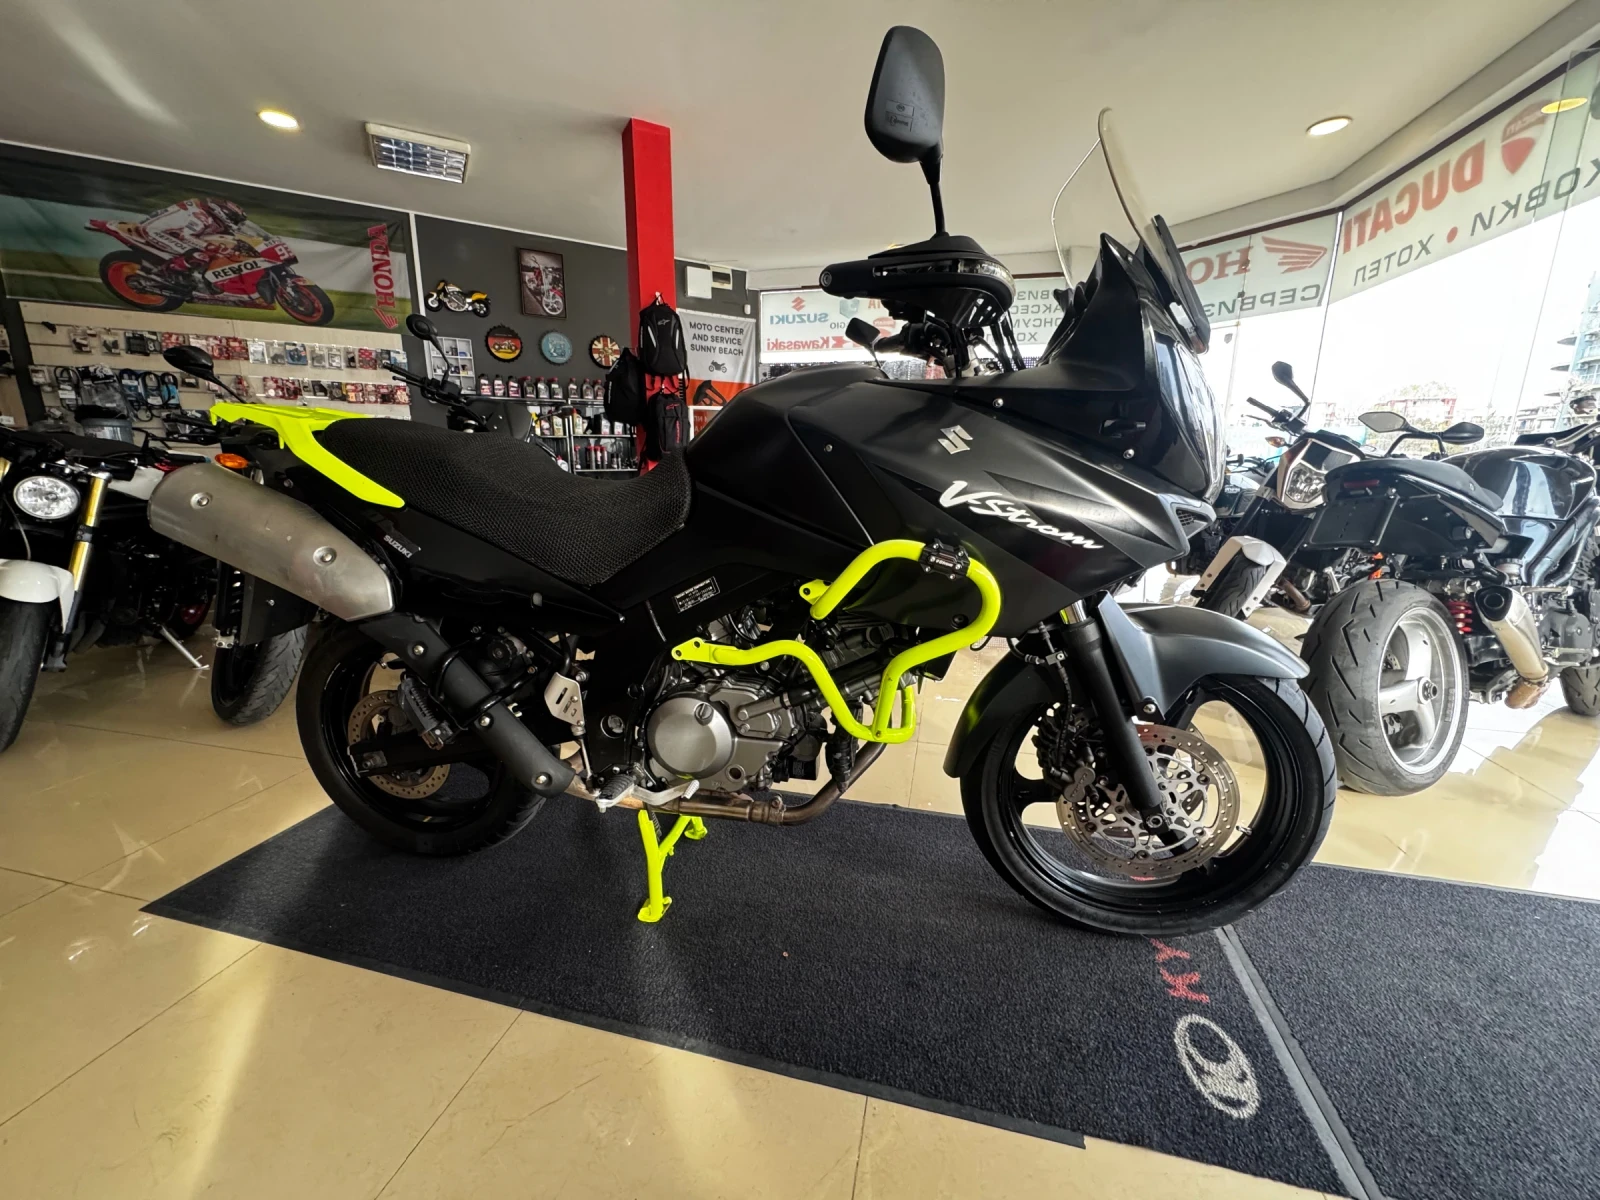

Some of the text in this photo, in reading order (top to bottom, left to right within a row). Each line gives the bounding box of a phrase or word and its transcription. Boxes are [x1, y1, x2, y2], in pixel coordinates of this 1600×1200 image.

[367, 223, 396, 309] HONDA
[689, 321, 744, 335] MOTO CENTER
[692, 333, 742, 346] AND SERVICE
[690, 343, 744, 357] SUNNY BEACH
[383, 534, 413, 559] SUZUKI
[1150, 938, 1210, 1003] KY
